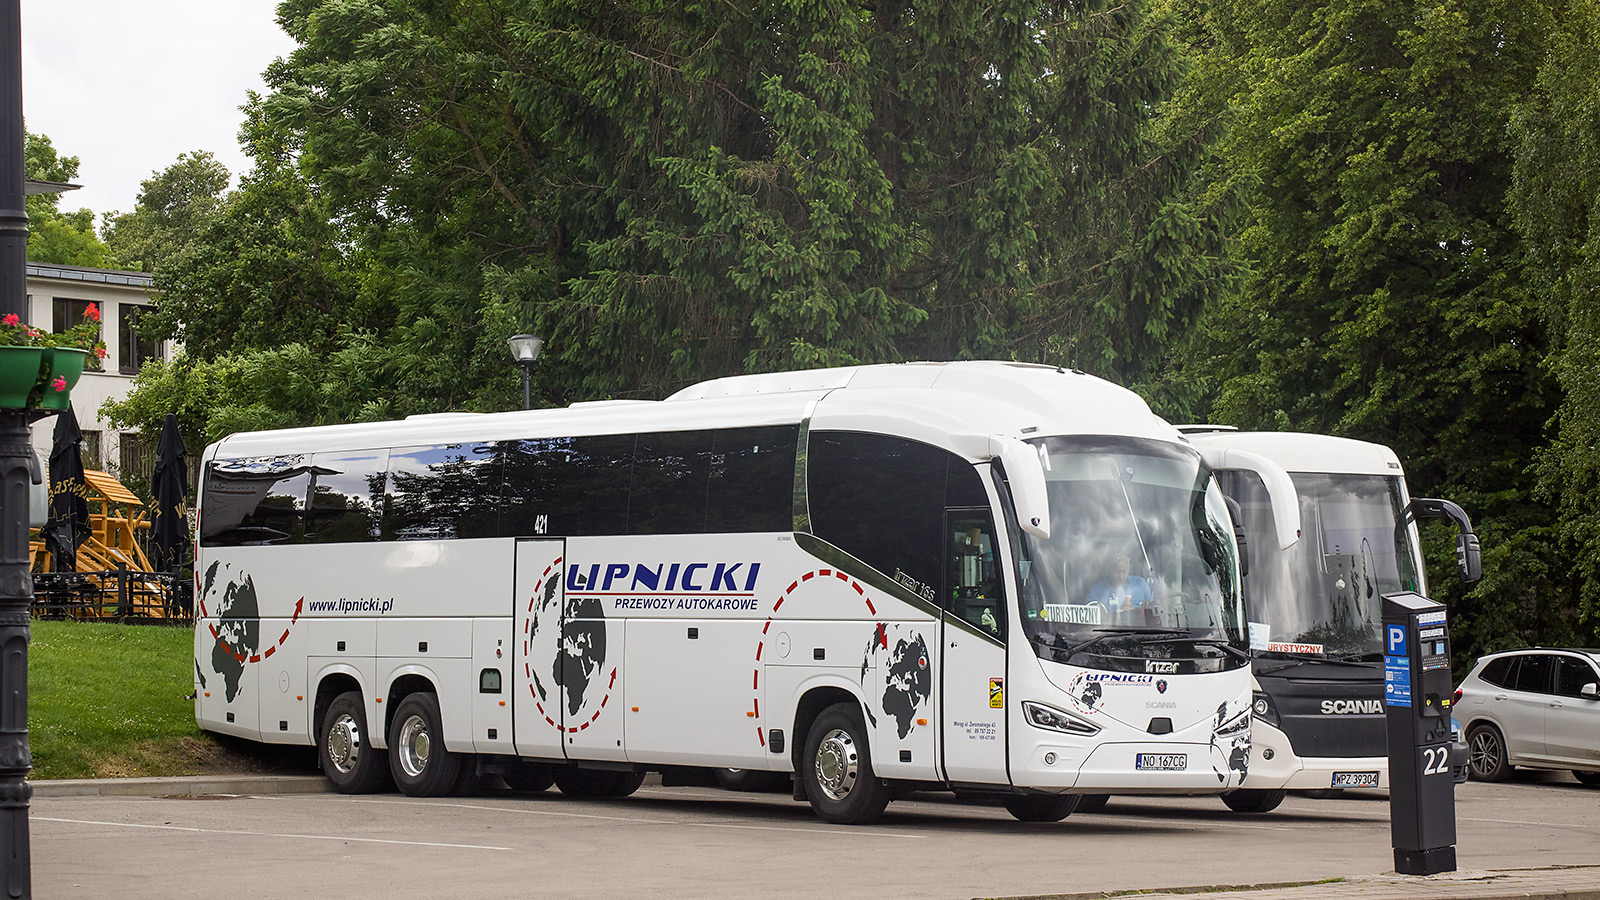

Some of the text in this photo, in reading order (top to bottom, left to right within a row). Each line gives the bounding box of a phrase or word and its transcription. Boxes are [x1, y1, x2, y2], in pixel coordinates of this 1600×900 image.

[534, 514, 548, 534] 421
[566, 563, 761, 591] LIPNICKI
[309, 597, 394, 614] www.lipnicki.pl
[614, 598, 758, 610] PRZEWOZY AUTOKAROWE
[1046, 605, 1099, 624] TURYSTYCZNY
[1389, 627, 1404, 651] P
[1267, 643, 1321, 654] URYSTYCZNY
[1086, 674, 1153, 683] LIPNICKI
[1145, 701, 1177, 709] SCANIA
[1320, 699, 1384, 714] SCANIA
[1143, 755, 1185, 767] NO 167CG
[1423, 746, 1449, 776] 22
[1336, 774, 1378, 785] WPZ 39304
